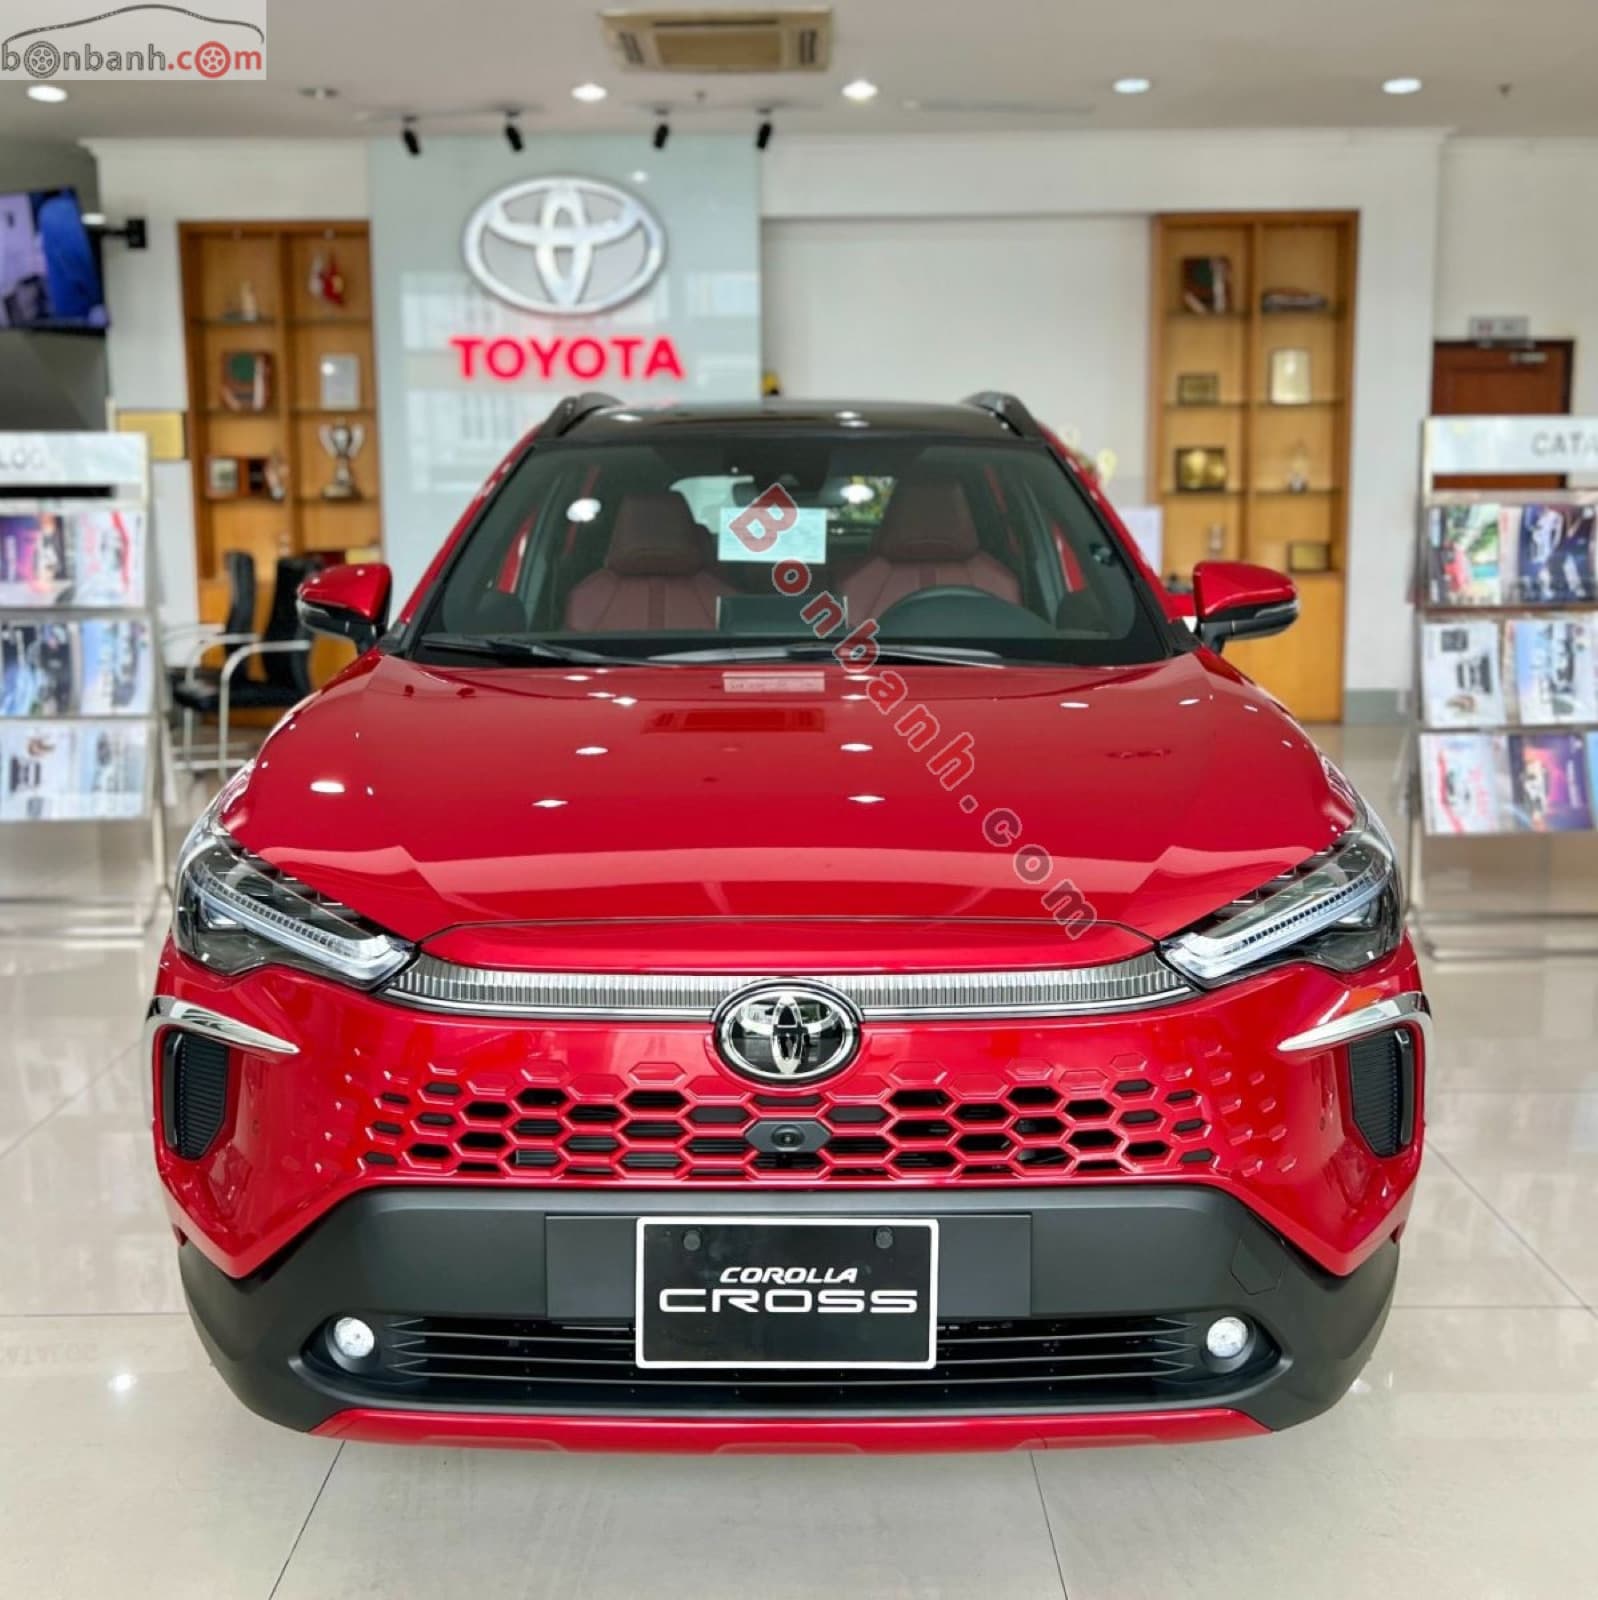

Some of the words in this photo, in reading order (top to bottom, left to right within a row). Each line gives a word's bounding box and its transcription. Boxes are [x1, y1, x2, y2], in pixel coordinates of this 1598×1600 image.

[450, 336, 686, 381] TOYOTA
[719, 1266, 858, 1285] COROLLA
[658, 1288, 918, 1314] CROSS
